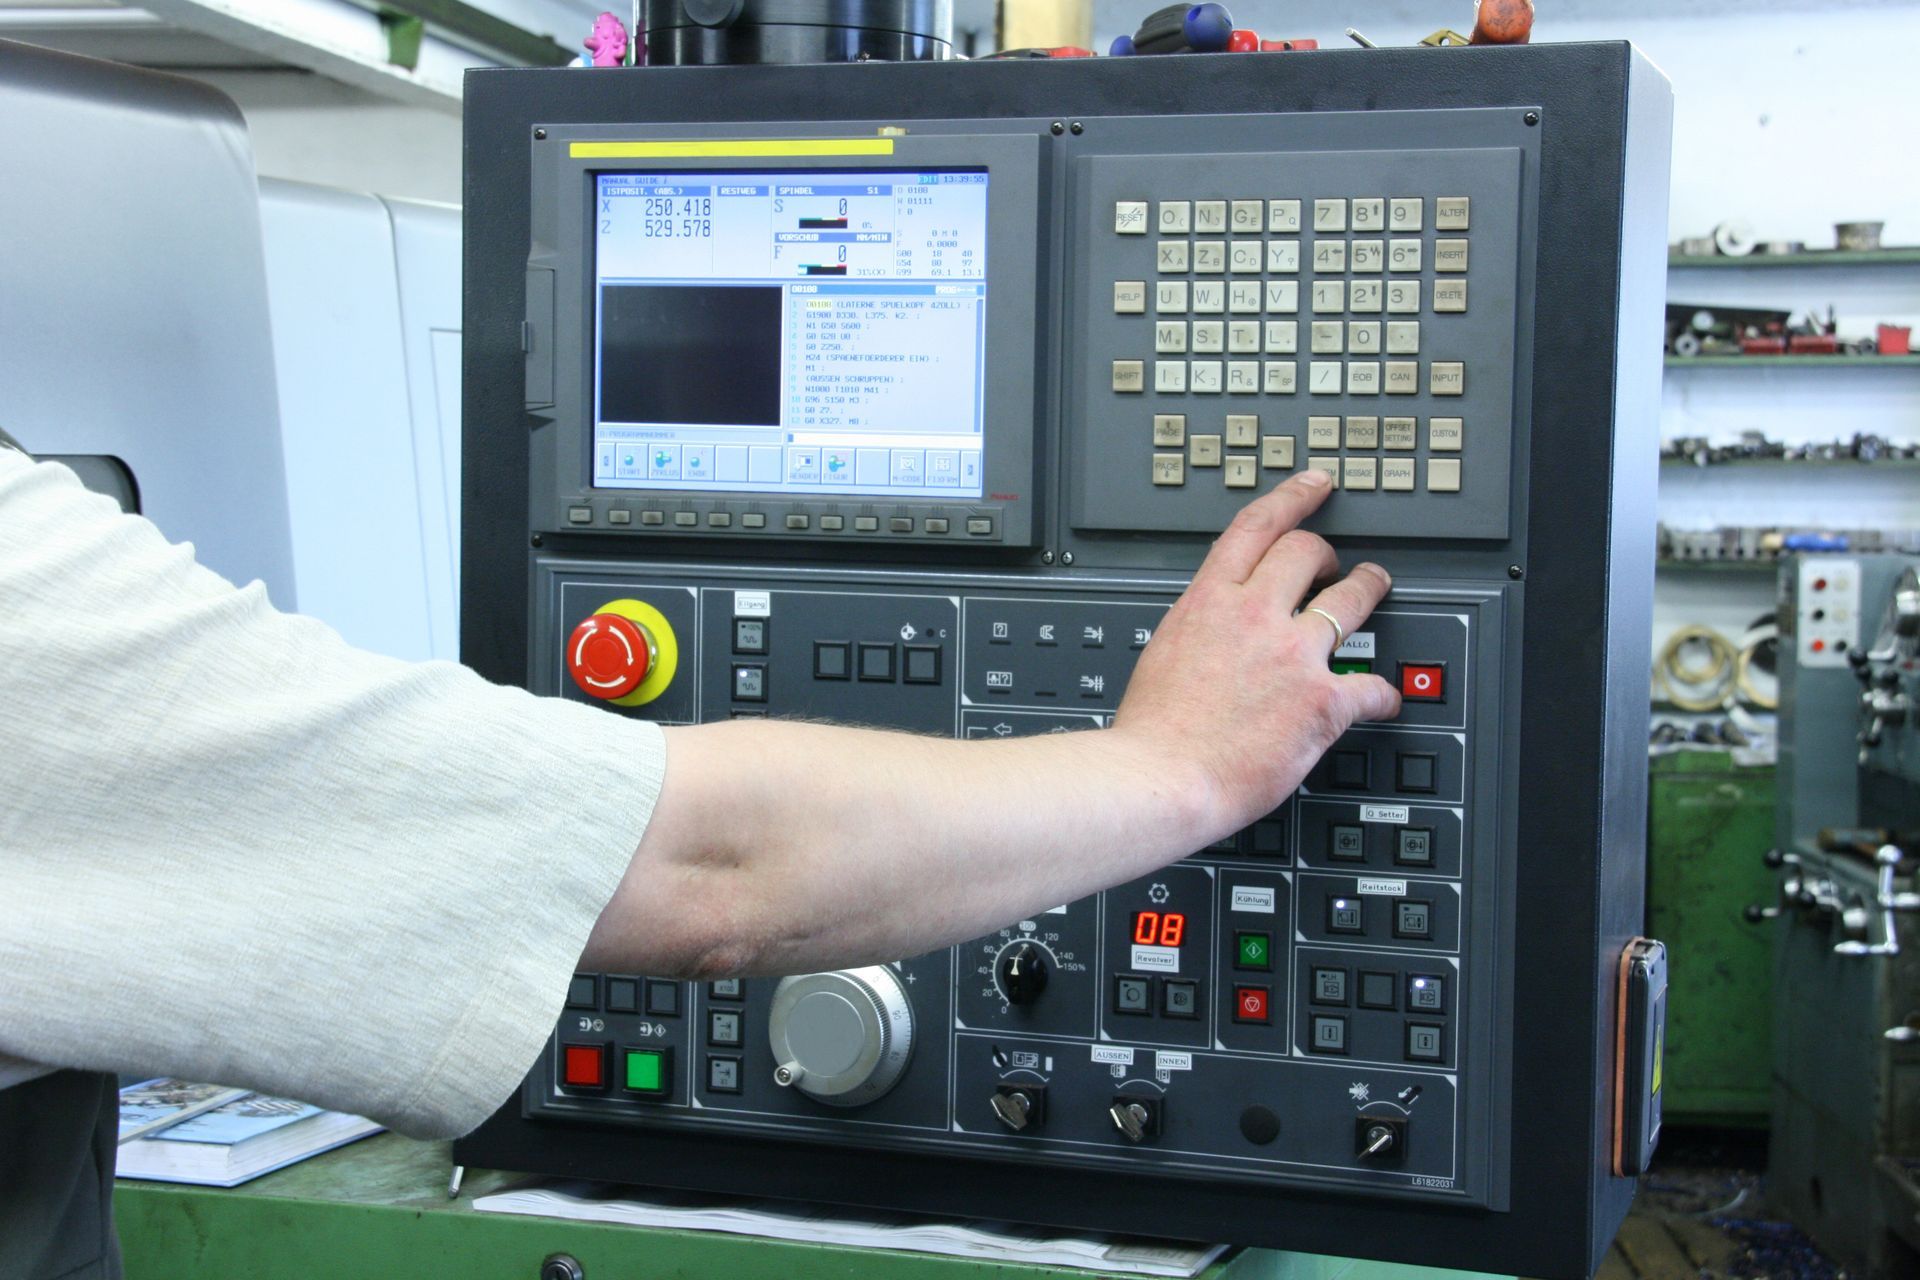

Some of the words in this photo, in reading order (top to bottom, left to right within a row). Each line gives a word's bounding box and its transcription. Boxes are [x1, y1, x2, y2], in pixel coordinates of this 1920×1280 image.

[944, 175, 984, 183] 13:39:55
[602, 200, 610, 212] X
[645, 198, 711, 216] 250.418
[774, 198, 784, 213] S
[839, 198, 847, 216] 0
[1394, 206, 1406, 221] 9
[1439, 209, 1465, 217] ALTER
[1117, 213, 1144, 222] RESET
[1199, 209, 1211, 223] N
[1234, 209, 1247, 224] G
[1251, 217, 1256, 226] E
[1273, 209, 1285, 222] P
[1289, 217, 1297, 226] Q
[1318, 208, 1330, 222] 7
[1356, 207, 1368, 222] 8
[601, 220, 611, 234] Z
[645, 220, 711, 237] 529.578
[774, 245, 783, 259] F
[838, 245, 847, 262] 0
[1161, 249, 1172, 263] X
[1176, 257, 1184, 266] A
[1198, 250, 1209, 264] Z
[1234, 249, 1247, 264] C
[1271, 249, 1284, 263] Y
[1317, 249, 1329, 264] 4
[1355, 248, 1367, 263] 5
[1393, 248, 1405, 263] 6
[1437, 251, 1465, 259] INSERT
[1117, 293, 1141, 301] HELP
[1161, 290, 1172, 304] U
[1196, 290, 1210, 303] W
[1234, 290, 1245, 304] H
[1270, 290, 1283, 304] V
[1317, 289, 1325, 303] 1
[1354, 288, 1367, 303] 2
[1390, 288, 1403, 304] 3
[1436, 291, 1463, 299] DELETE
[1158, 330, 1171, 344] M
[1196, 330, 1208, 344] S
[1232, 329, 1245, 343] T
[1269, 330, 1280, 344] L
[1115, 372, 1140, 380] SHIFT
[1194, 369, 1206, 383] K
[1231, 370, 1243, 383] R
[1268, 369, 1280, 383] F
[1390, 373, 1410, 381] CAN
[1432, 374, 1460, 382] INPUT
[1313, 428, 1333, 436] POS
[1385, 423, 1411, 431] OFFSET
[1431, 429, 1458, 438] CUSTOM
[1384, 434, 1412, 442] SETTING
[1155, 463, 1179, 471] PAGE
[1346, 469, 1373, 477] MESSAGE
[1384, 469, 1410, 477] GRAPH
[940, 629, 946, 638] C
[1378, 811, 1404, 819] Setter
[1362, 883, 1402, 892] Reitstock
[1237, 895, 1269, 906] Kühlung
[1135, 911, 1184, 946] 08
[1045, 933, 1059, 941] 120
[984, 945, 994, 953] 60
[1060, 952, 1074, 960] 140
[1137, 955, 1172, 963] Revolver
[1064, 963, 1086, 971] 150%
[982, 989, 992, 997] 20
[1096, 1051, 1129, 1060] AUSSEN
[1412, 1176, 1454, 1189] L61822031
